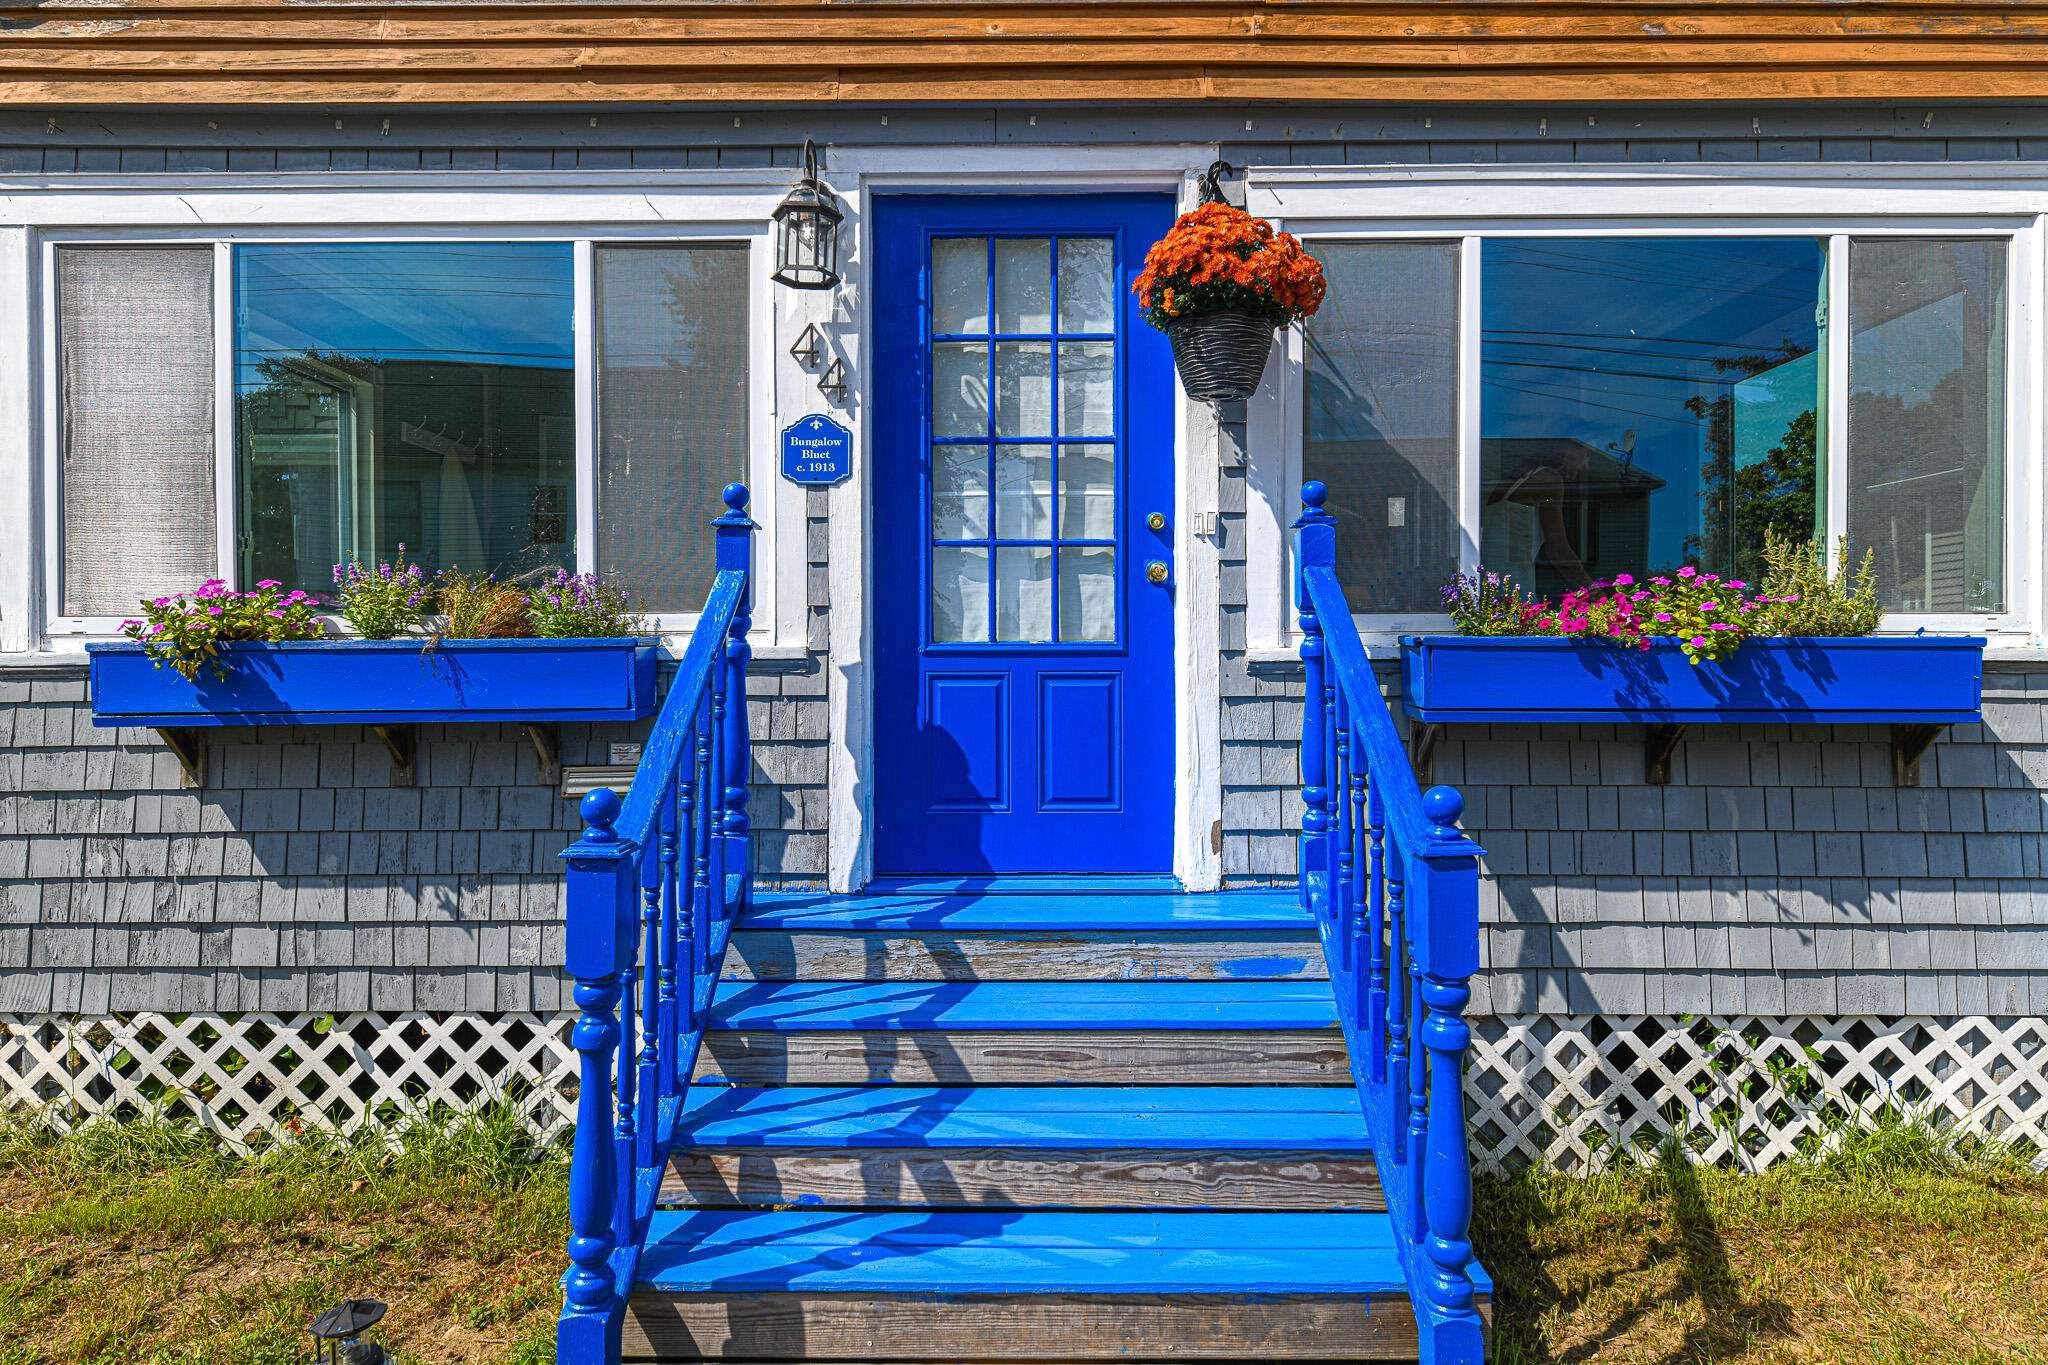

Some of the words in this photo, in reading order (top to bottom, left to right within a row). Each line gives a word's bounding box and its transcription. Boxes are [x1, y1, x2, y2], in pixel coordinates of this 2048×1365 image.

[790, 437, 842, 448] Bungalow
[796, 464, 806, 472] c.
[809, 462, 836, 472] 1913
